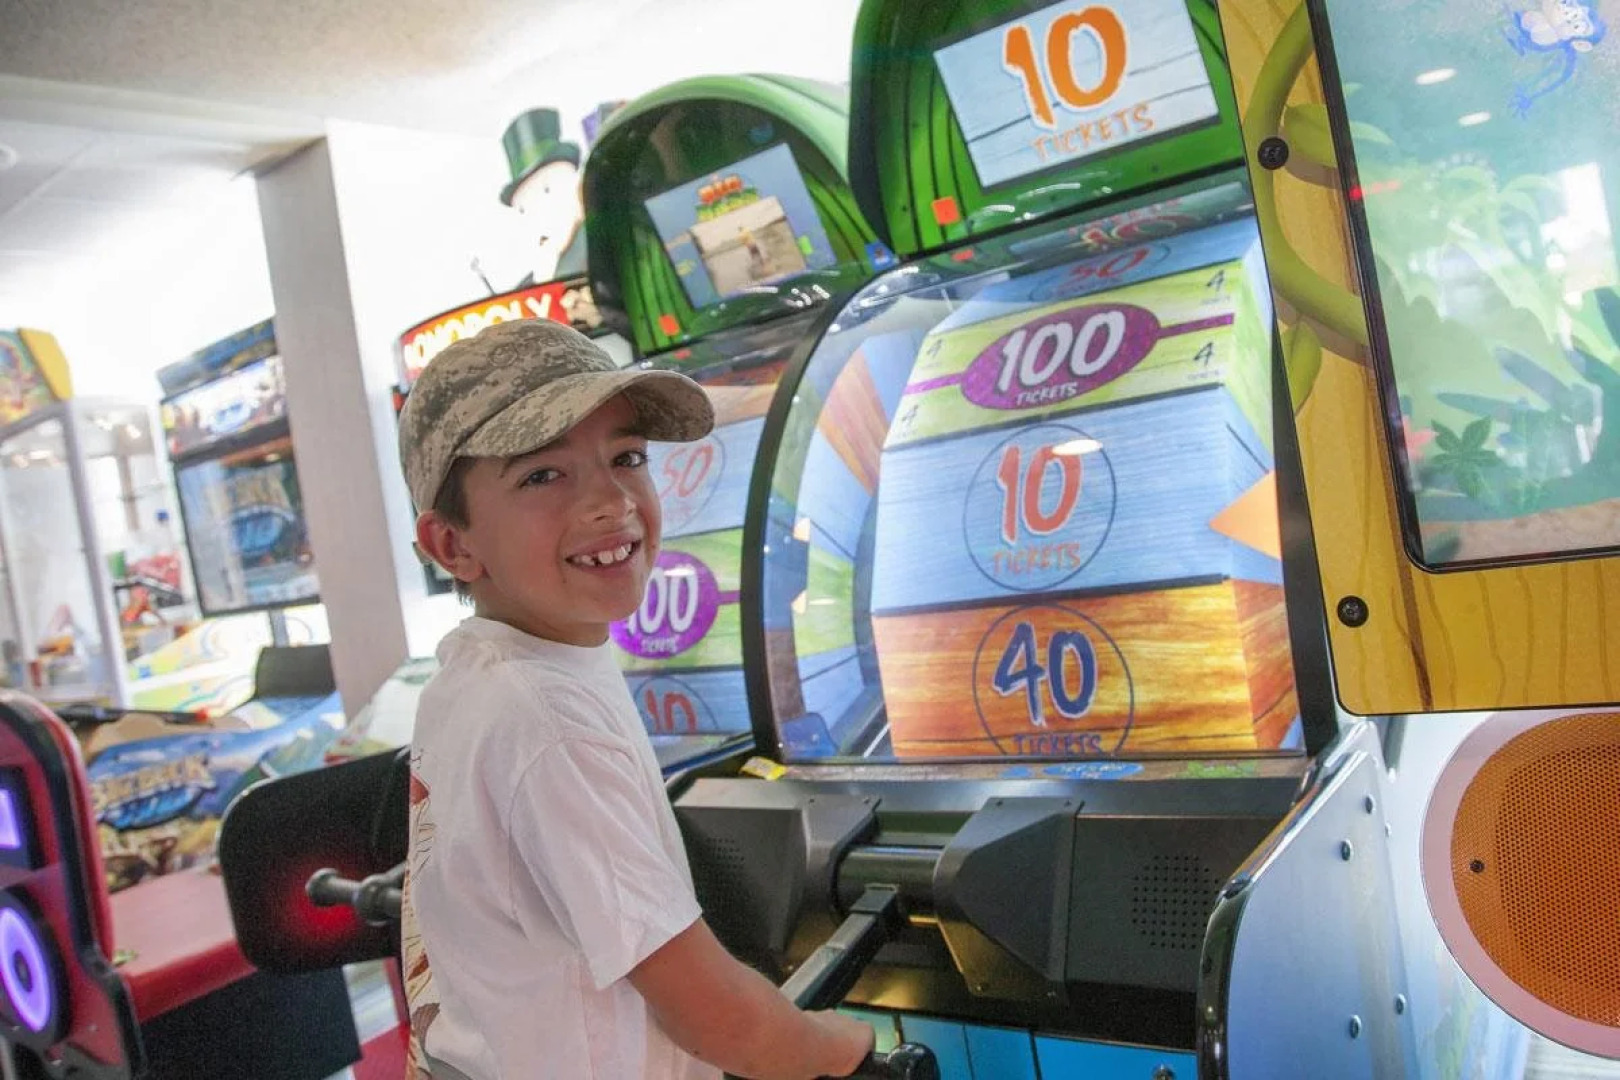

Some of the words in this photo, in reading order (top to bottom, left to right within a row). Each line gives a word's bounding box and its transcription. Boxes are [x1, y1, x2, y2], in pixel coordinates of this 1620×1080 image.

[1002, 5, 1128, 129] 10
[1030, 101, 1154, 162] TICKETS
[1206, 269, 1225, 292] 4
[998, 310, 1126, 393] 100
[1193, 342, 1213, 366] 4
[1015, 381, 1078, 405] TICKETS
[998, 444, 1082, 544] 10
[993, 542, 1081, 576] TICKETS
[628, 566, 699, 636] 00
[992, 621, 1098, 727] 40
[1012, 733, 1103, 757] TICKETS
